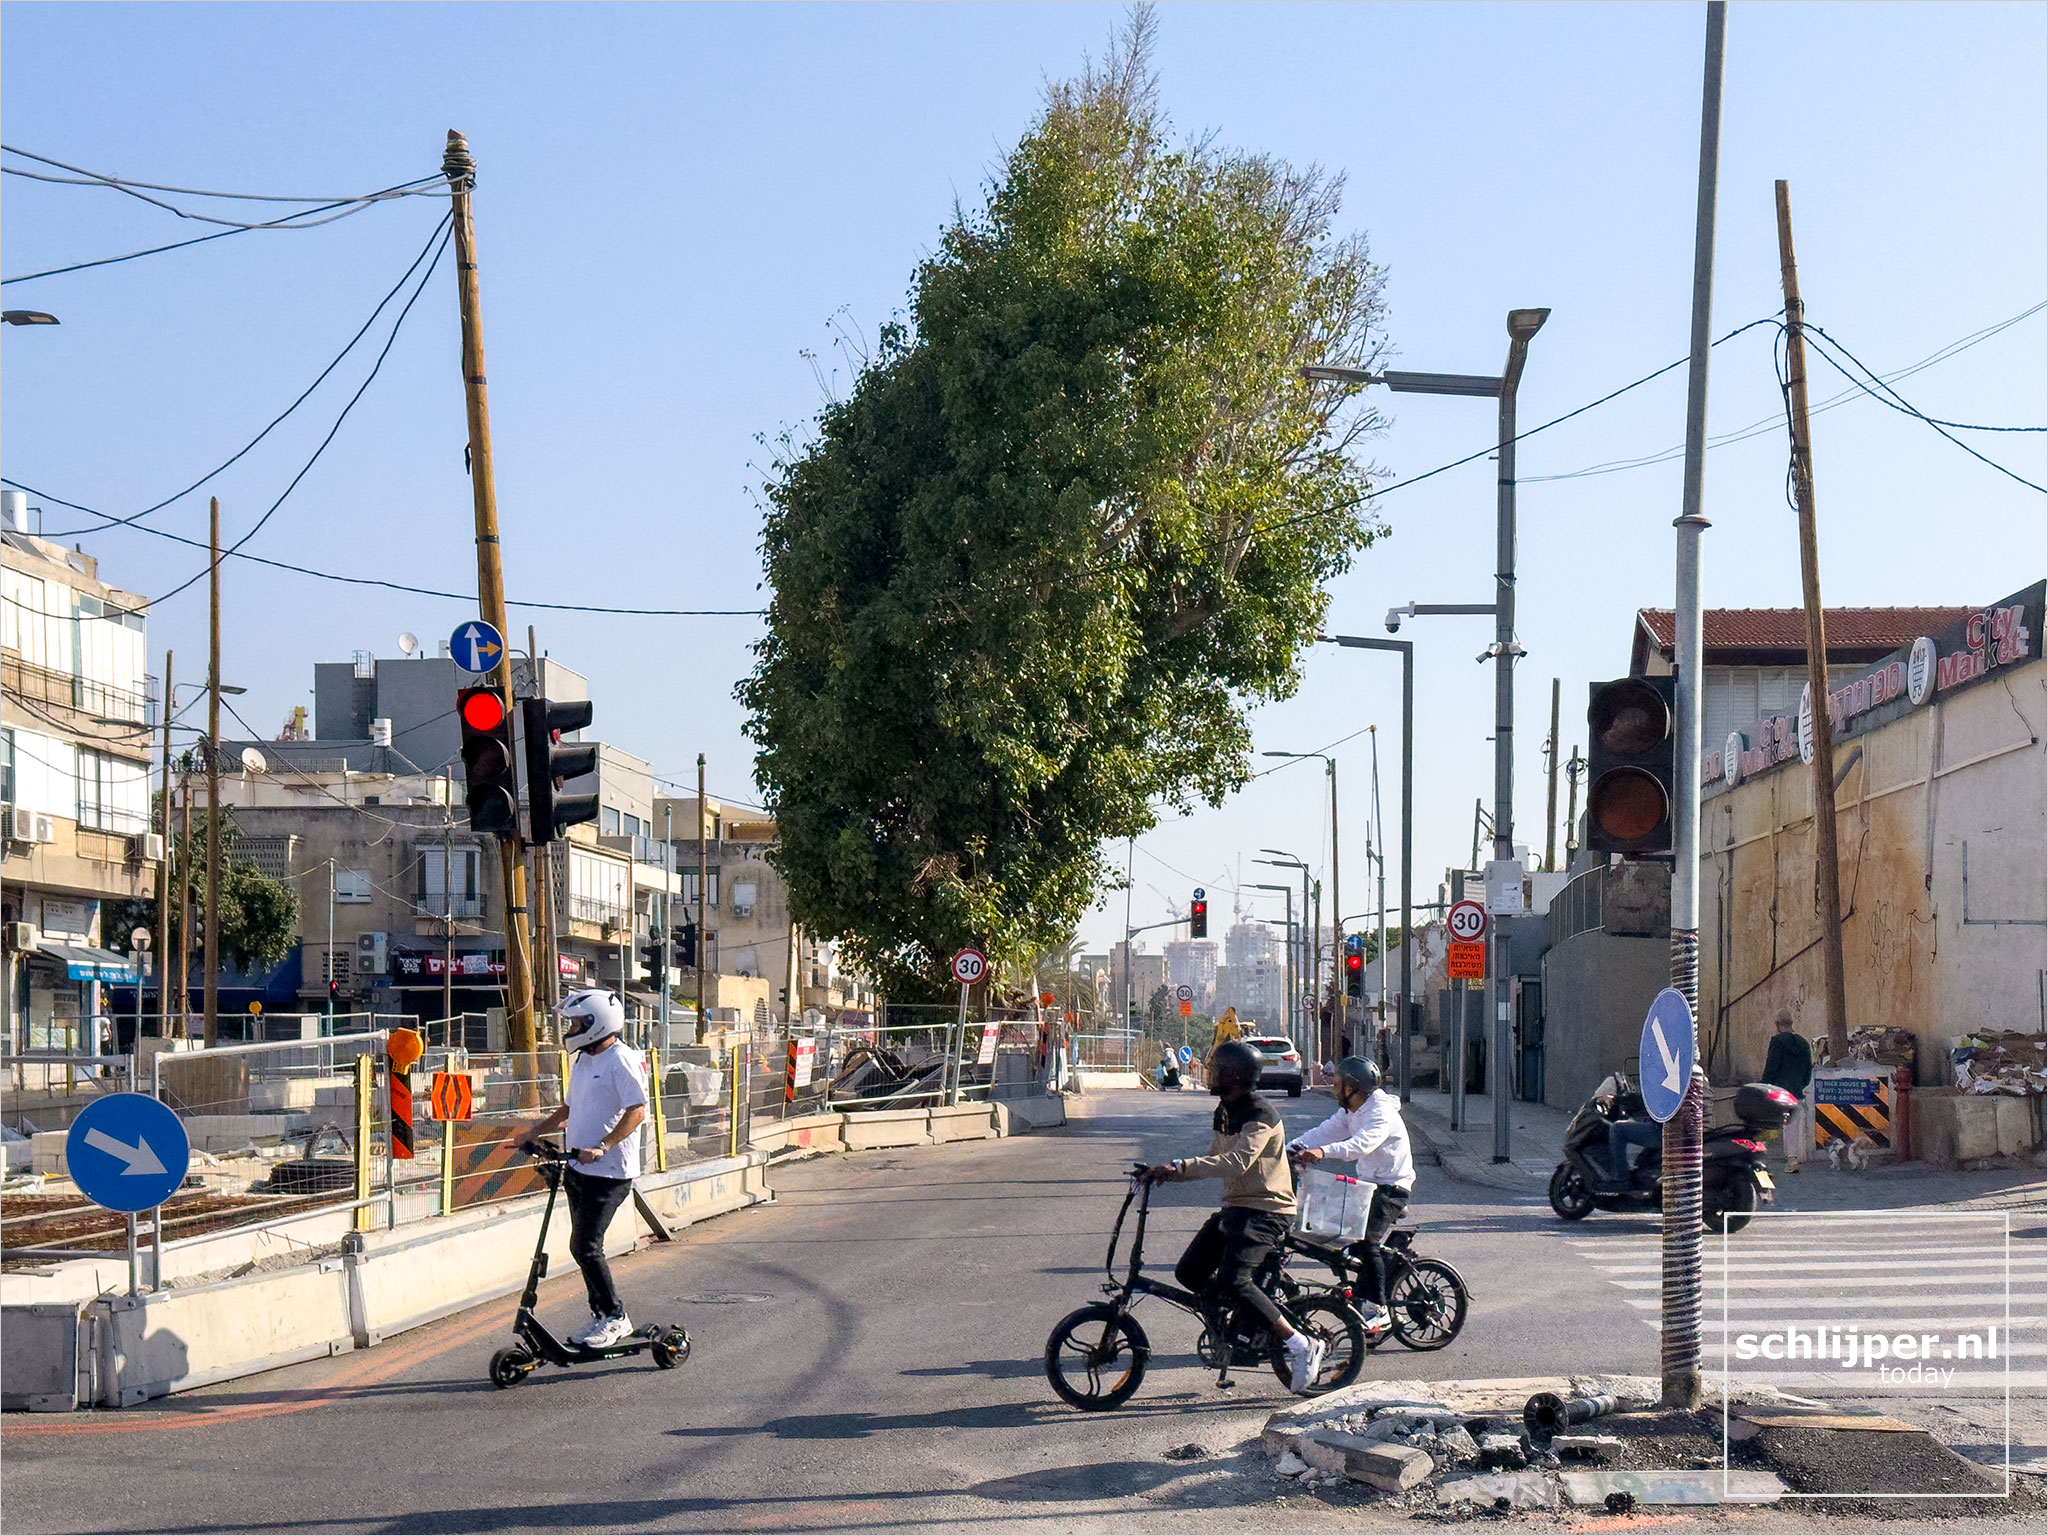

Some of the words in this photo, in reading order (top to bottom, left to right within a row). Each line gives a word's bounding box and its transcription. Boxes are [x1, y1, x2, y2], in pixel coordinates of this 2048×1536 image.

[1966, 607, 2019, 650] City
[1937, 629, 2023, 691] Market
[1454, 912, 1480, 930] 30
[958, 958, 981, 975] 30
[1179, 989, 1191, 998] 30
